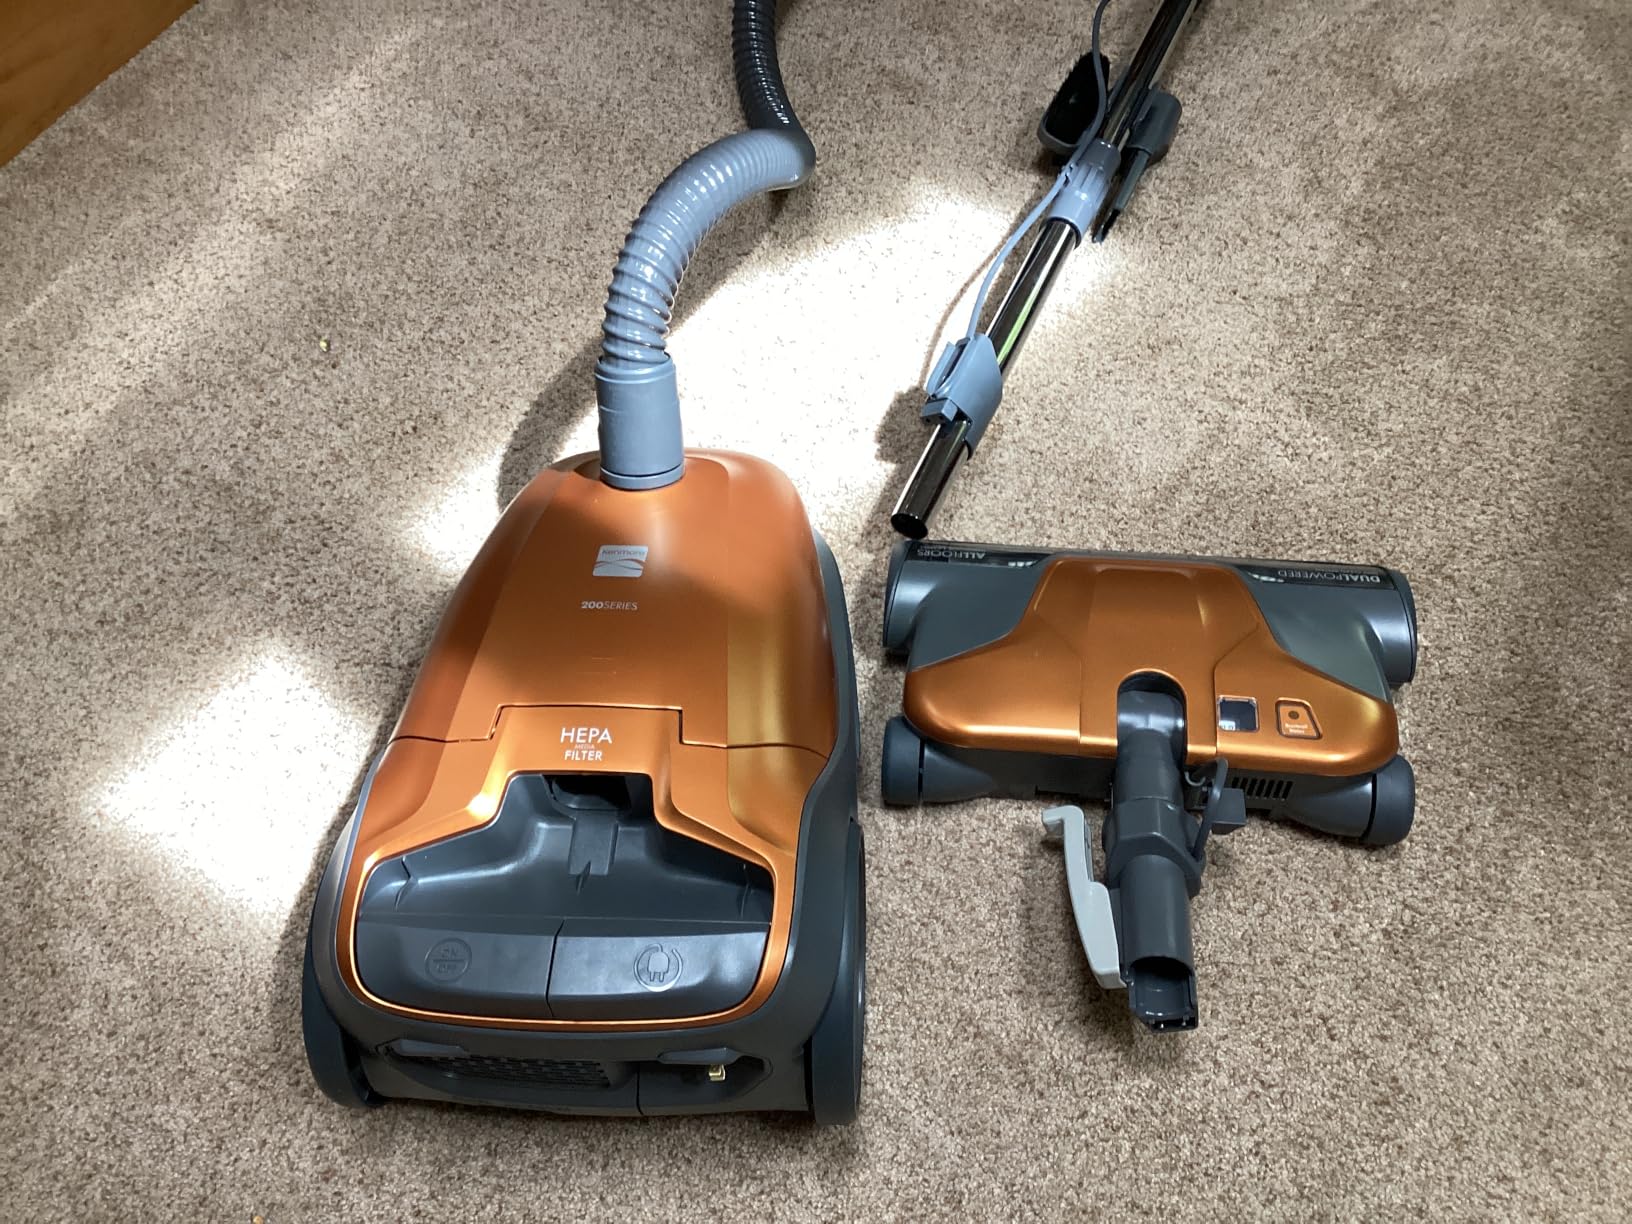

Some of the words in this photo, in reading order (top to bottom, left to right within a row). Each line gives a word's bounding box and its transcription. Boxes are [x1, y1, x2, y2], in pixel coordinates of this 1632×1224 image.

[1278, 569, 1380, 583] DUALPOWERED
[560, 727, 613, 744] HEPA
[564, 750, 603, 761] FILTER
